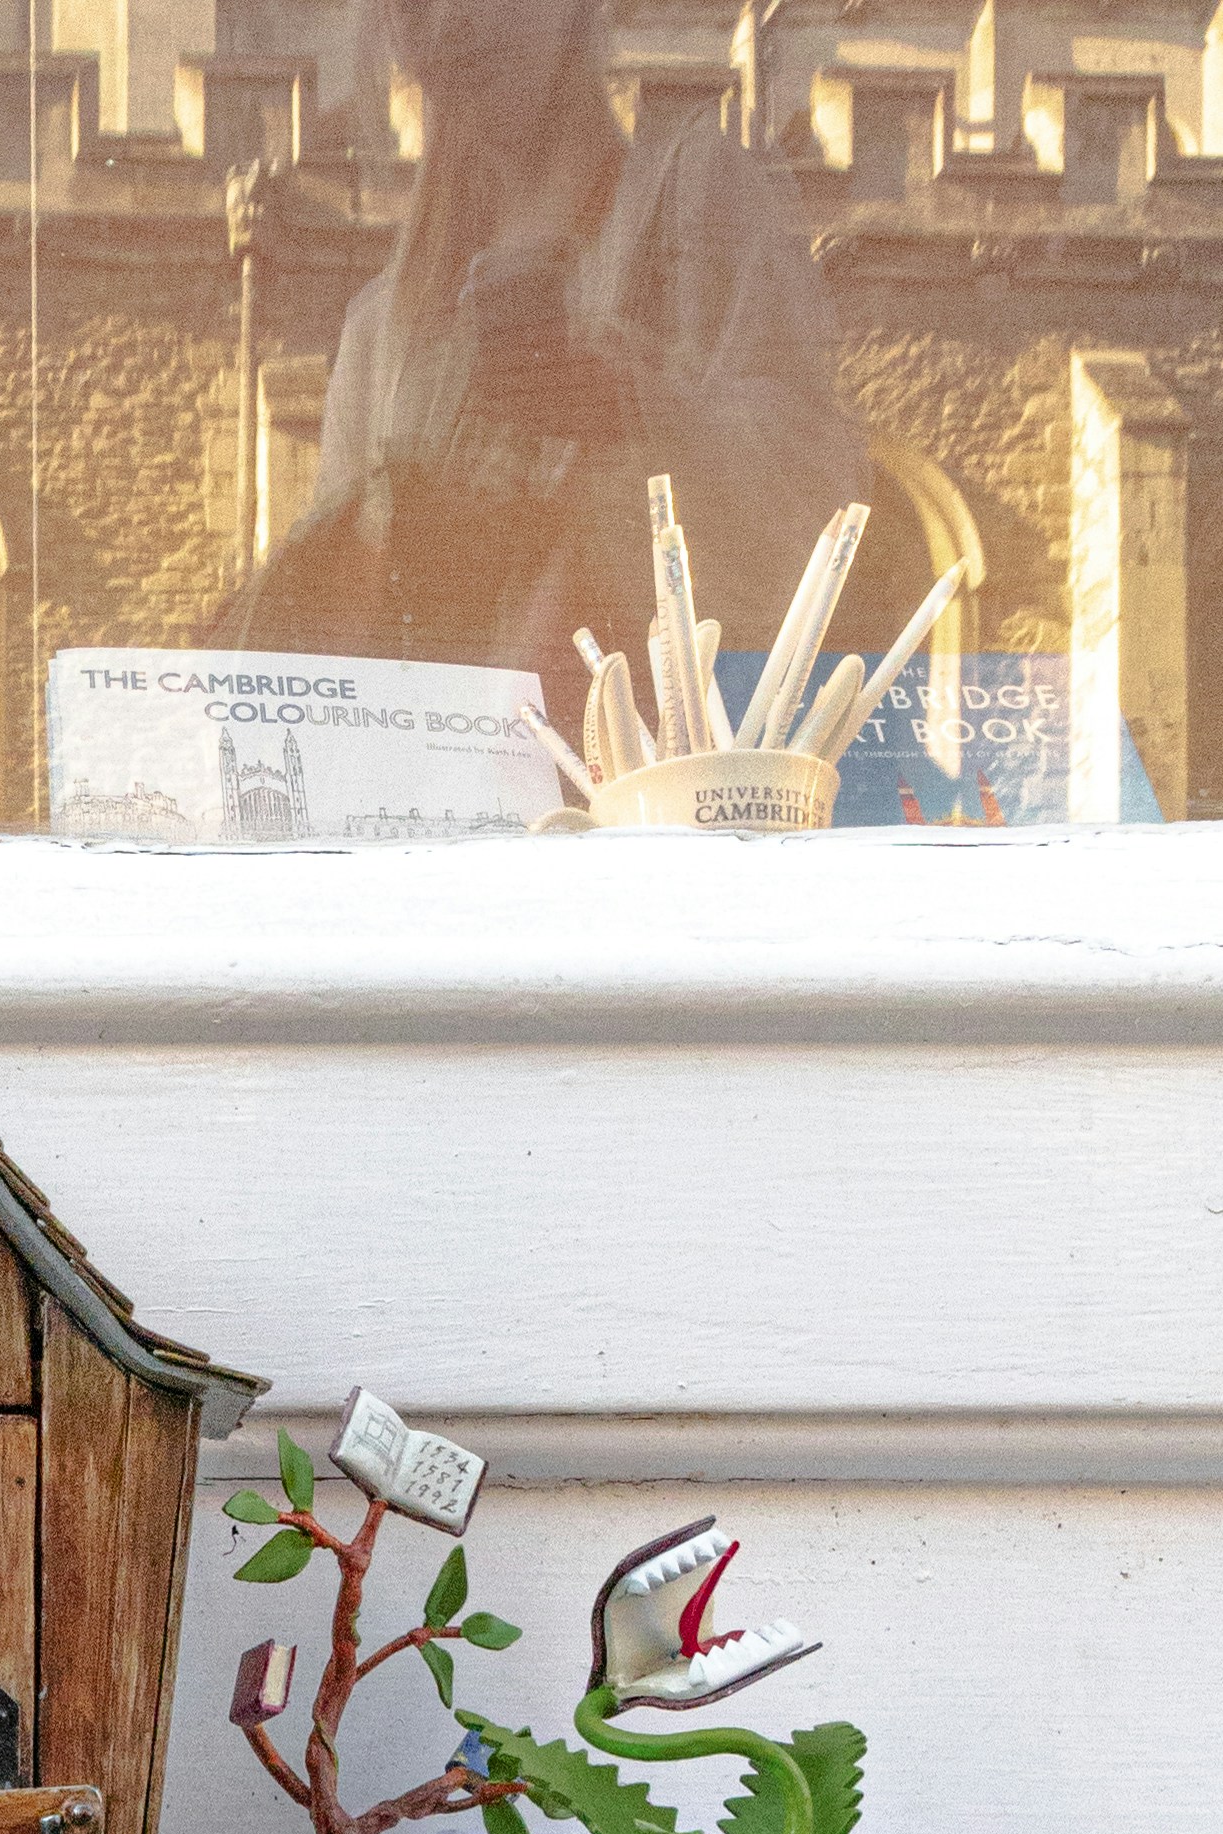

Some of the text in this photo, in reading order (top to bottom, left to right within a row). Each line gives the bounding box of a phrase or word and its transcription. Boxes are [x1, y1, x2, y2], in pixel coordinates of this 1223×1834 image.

[80, 668, 357, 701] THE CAMBRIDGE
[896, 665, 930, 681] HE
[202, 700, 528, 740] COLOURING BOOK
[912, 716, 1055, 744] BOOK
[694, 785, 811, 805] UNIVERSITY
[404, 1480, 458, 1514] 1992
